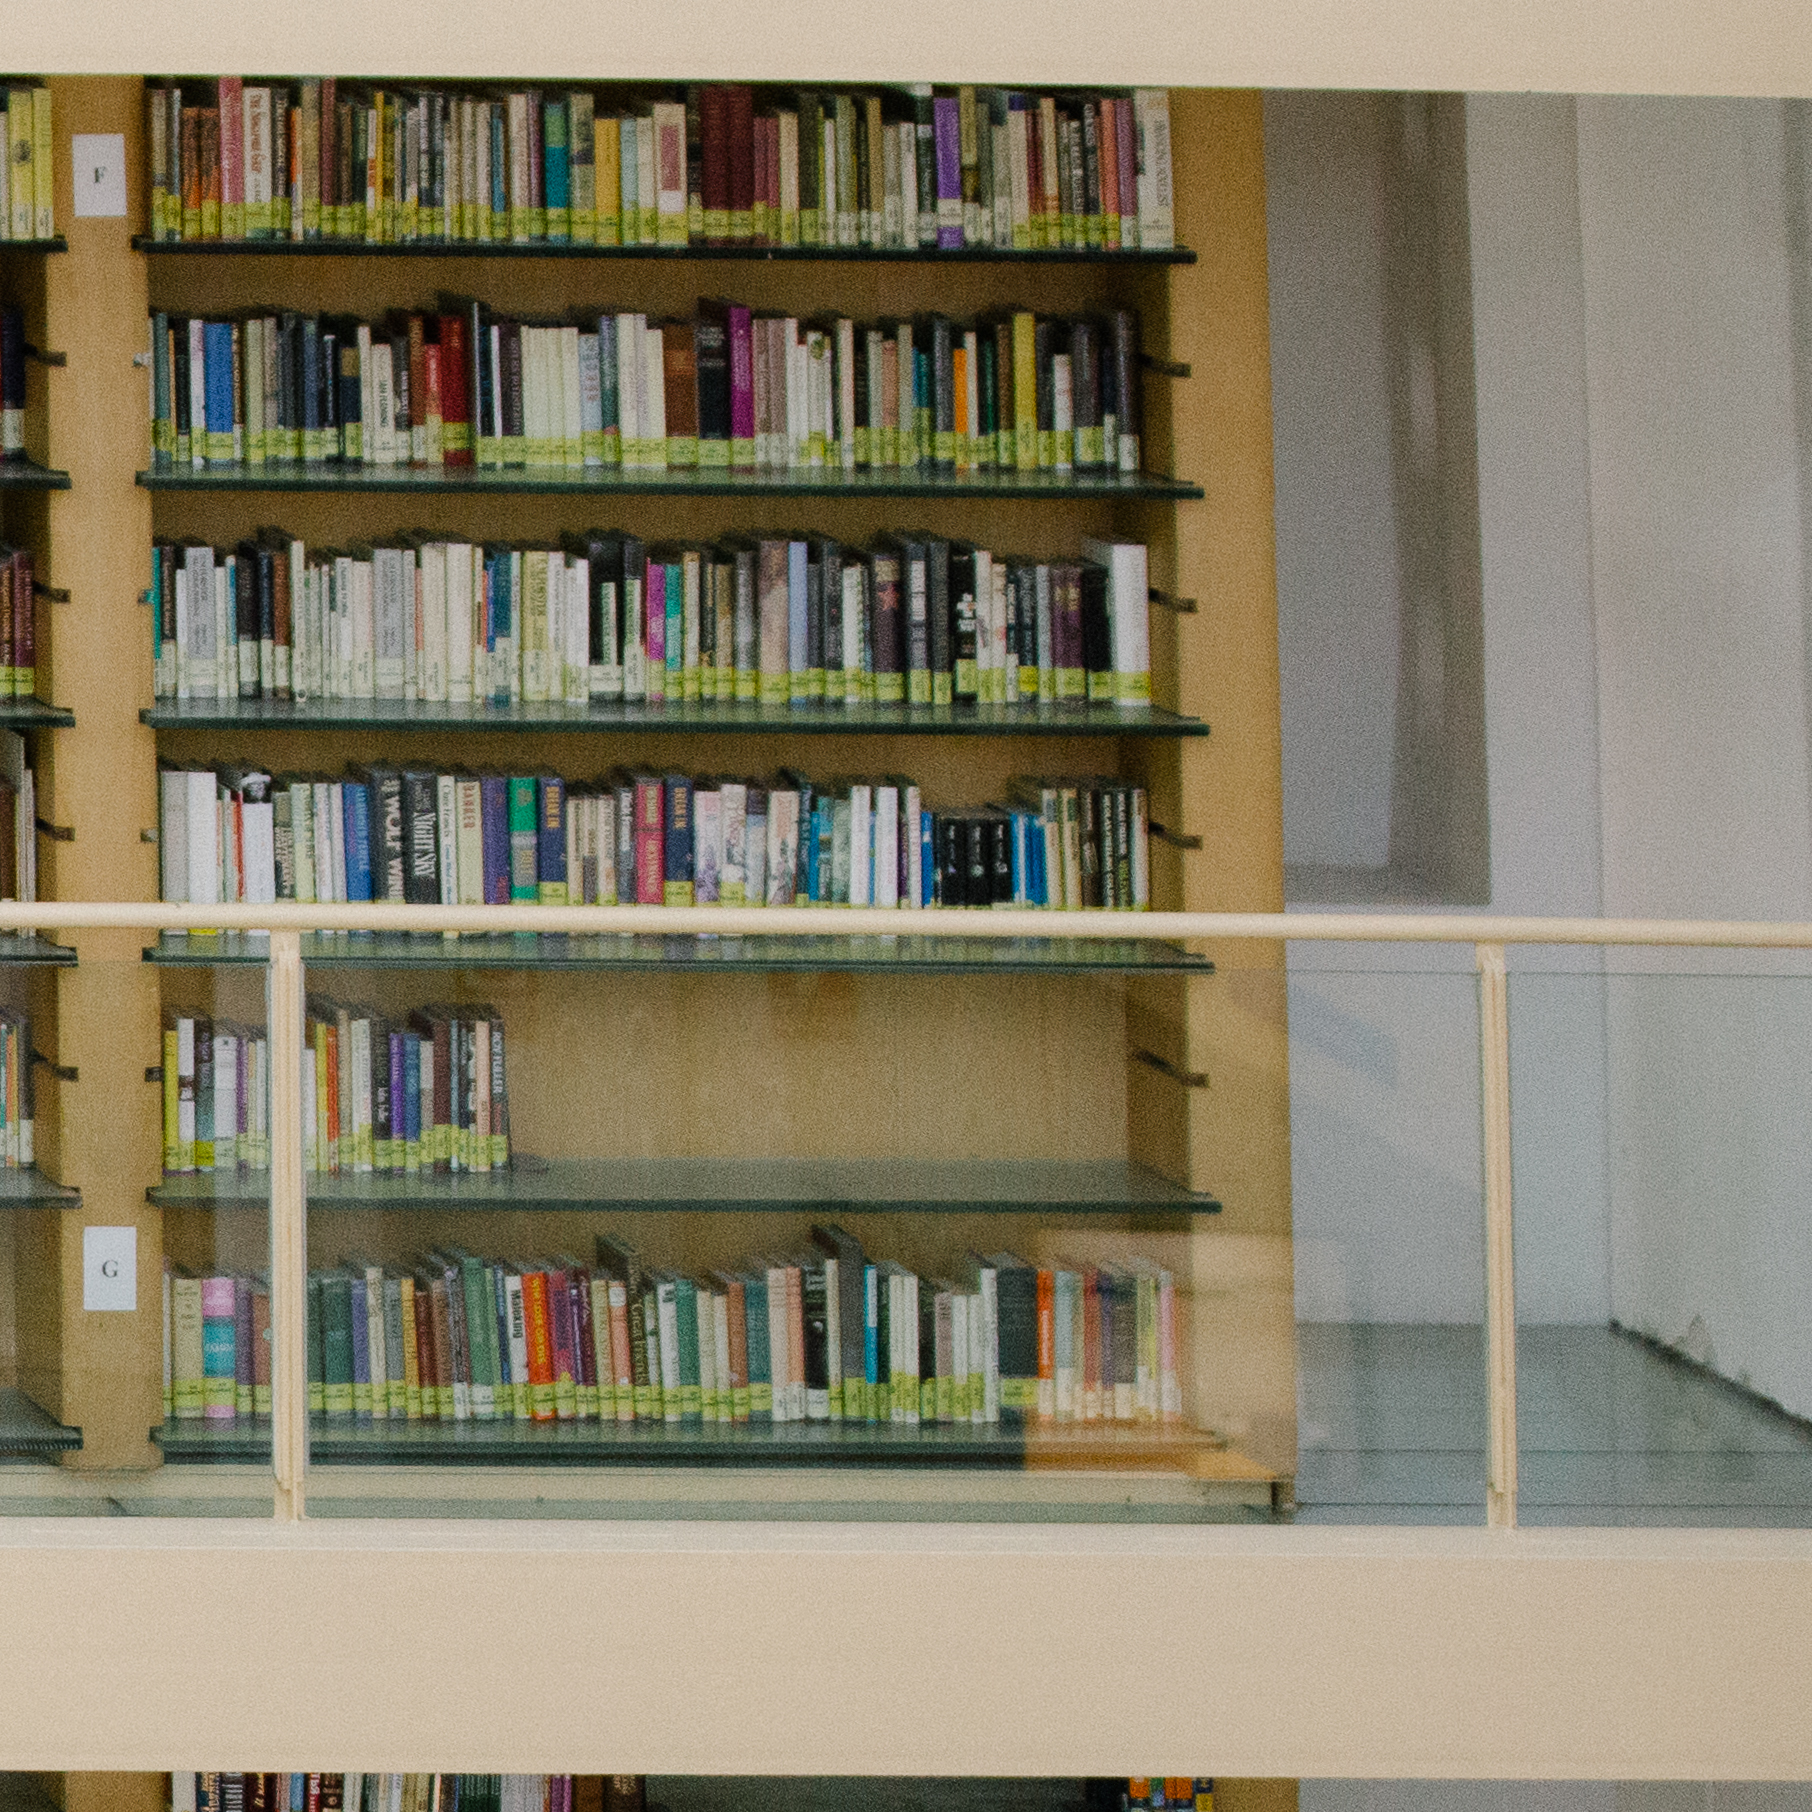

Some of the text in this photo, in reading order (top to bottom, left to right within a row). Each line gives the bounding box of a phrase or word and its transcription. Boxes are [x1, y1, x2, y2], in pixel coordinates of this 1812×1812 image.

[94, 165, 107, 185] F
[462, 783, 475, 830] BANKER
[413, 812, 436, 877] NIGHT SKY
[101, 1258, 119, 1279] G
